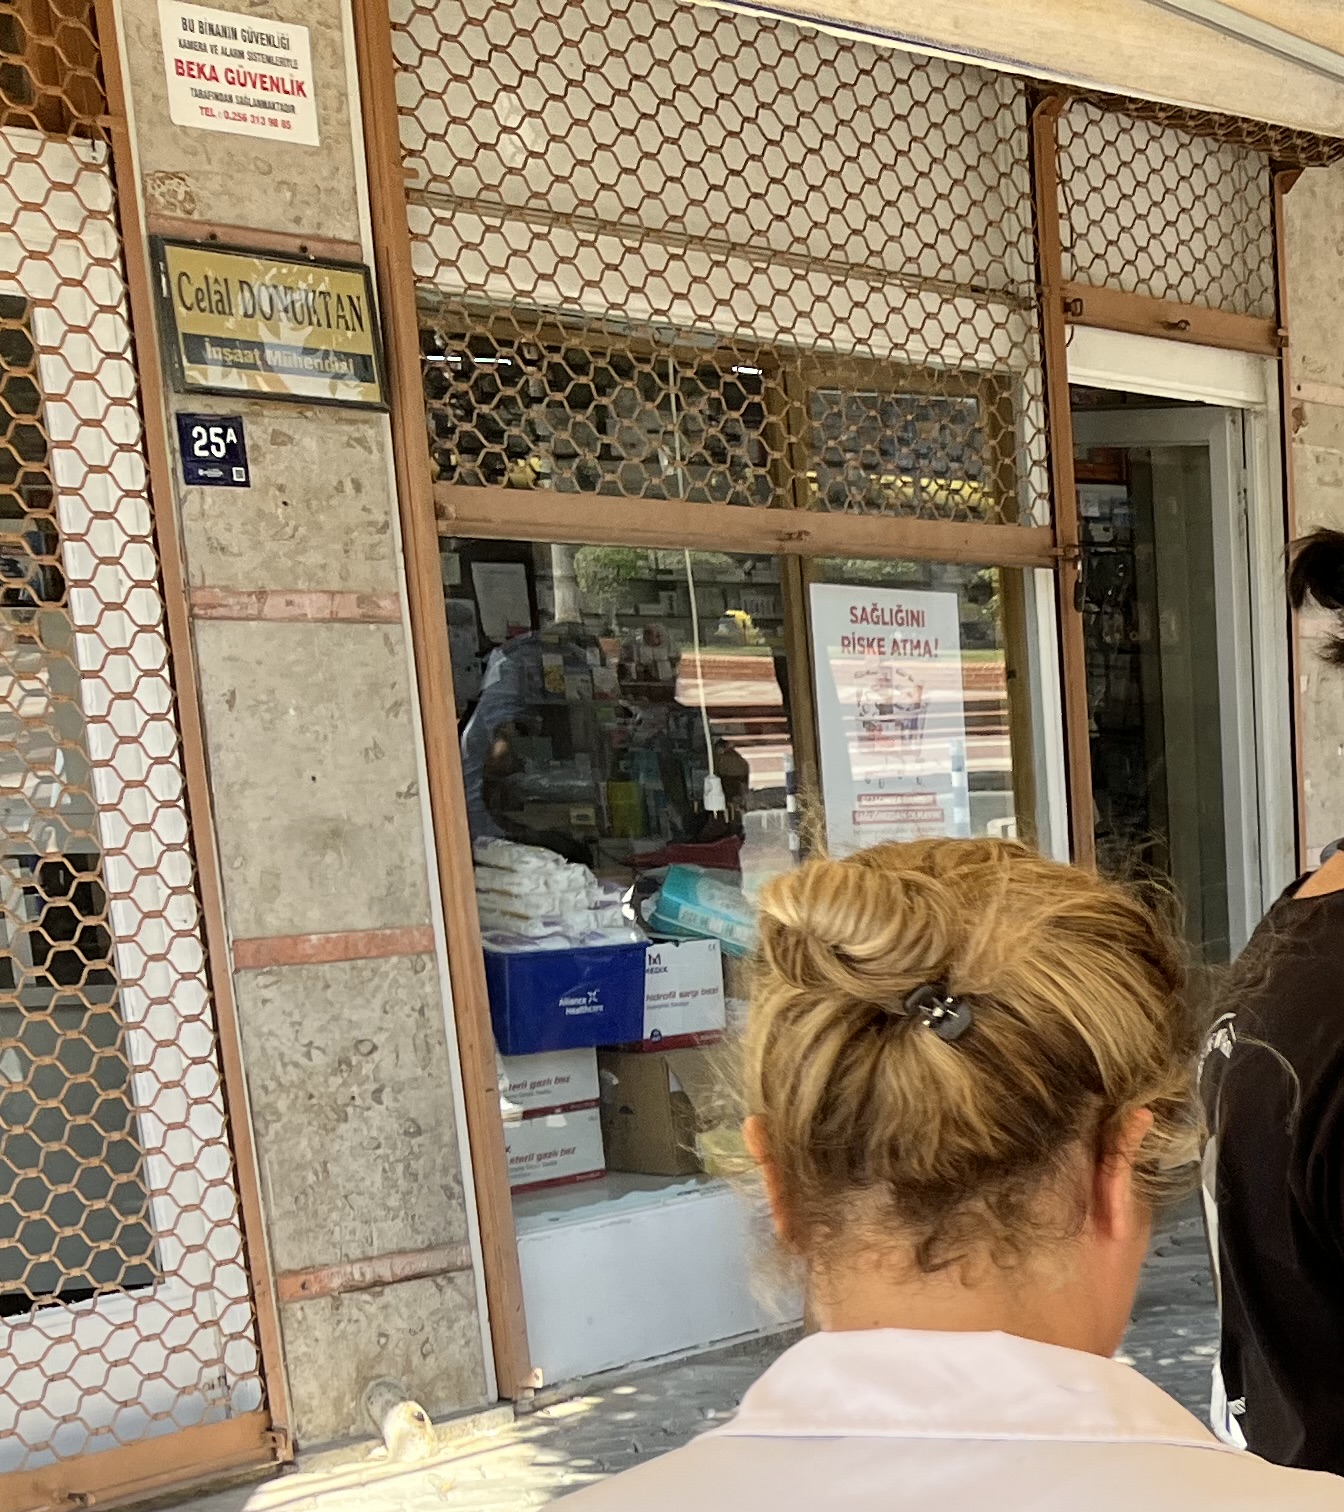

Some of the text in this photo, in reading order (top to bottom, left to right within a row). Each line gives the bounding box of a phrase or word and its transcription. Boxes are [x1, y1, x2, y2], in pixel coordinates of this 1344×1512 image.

[181, 17, 290, 51] BU BİNANIN GÜVENLİĞİ
[209, 44, 219, 56] VE
[174, 58, 307, 98] BEKA GÜVENLİK
[199, 106, 216, 118] TEL
[178, 271, 234, 317] Celâl
[850, 602, 926, 628] SAĞLIĞINI
[841, 632, 939, 658] RİSKE ATMA!
